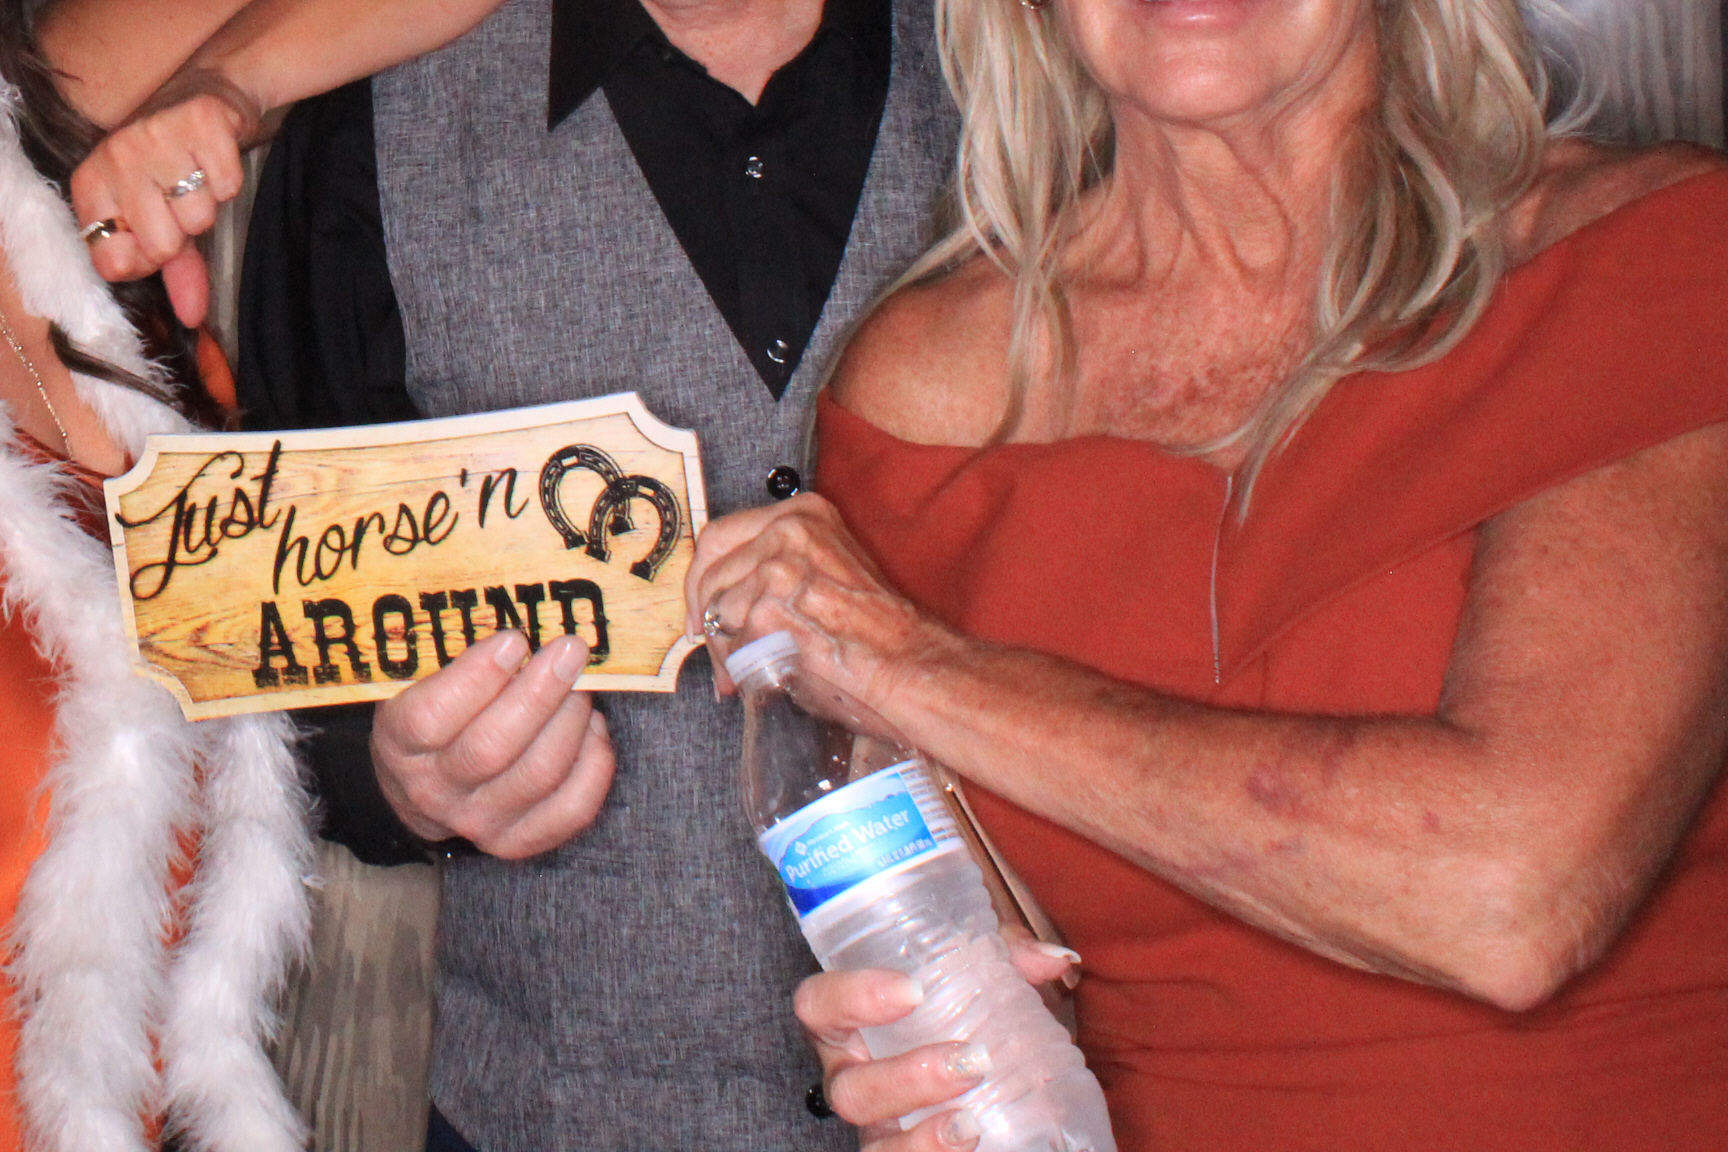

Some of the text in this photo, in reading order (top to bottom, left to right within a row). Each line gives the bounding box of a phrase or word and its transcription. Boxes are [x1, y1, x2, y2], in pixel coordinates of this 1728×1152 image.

[115, 440, 282, 601] Just
[785, 834, 854, 883] Purified
[851, 810, 910, 844] Water
